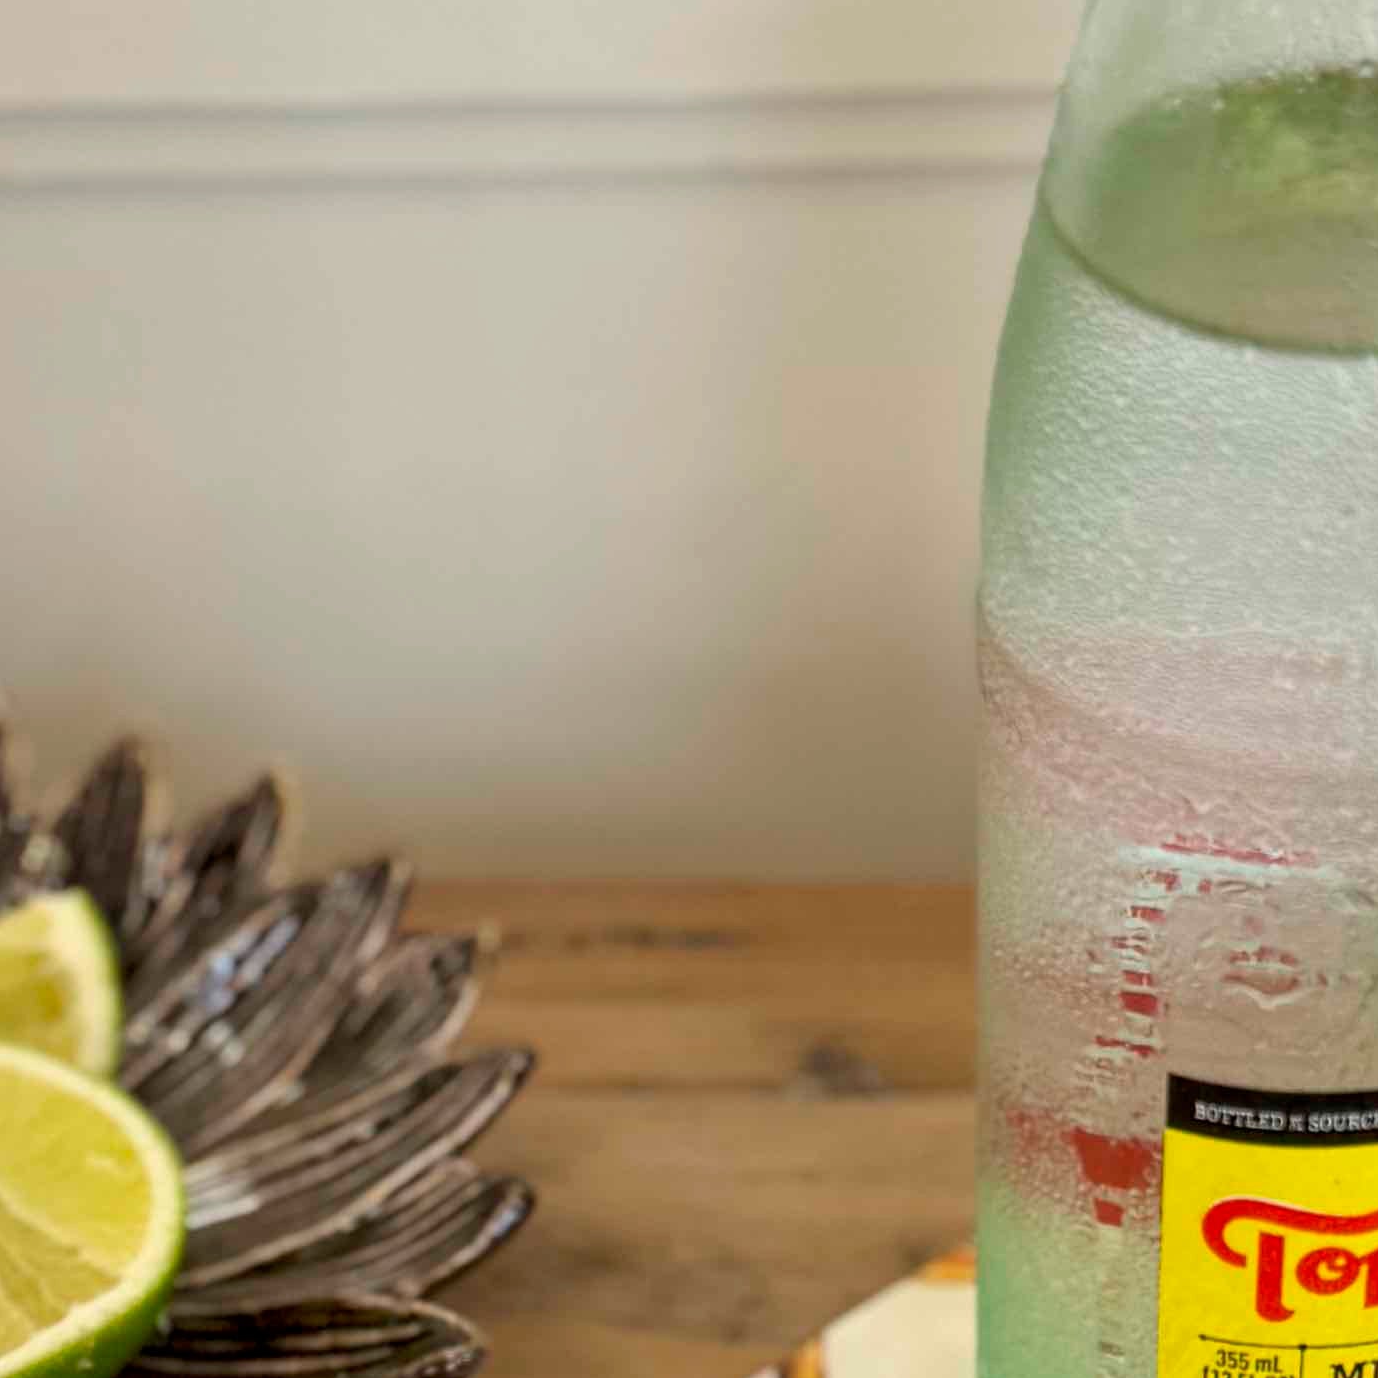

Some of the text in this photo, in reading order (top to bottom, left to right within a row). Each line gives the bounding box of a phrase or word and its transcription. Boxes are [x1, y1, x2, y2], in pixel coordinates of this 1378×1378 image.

[1194, 1101, 1286, 1131] BOTTLED
[1216, 1349, 1283, 1373] 355 mL
